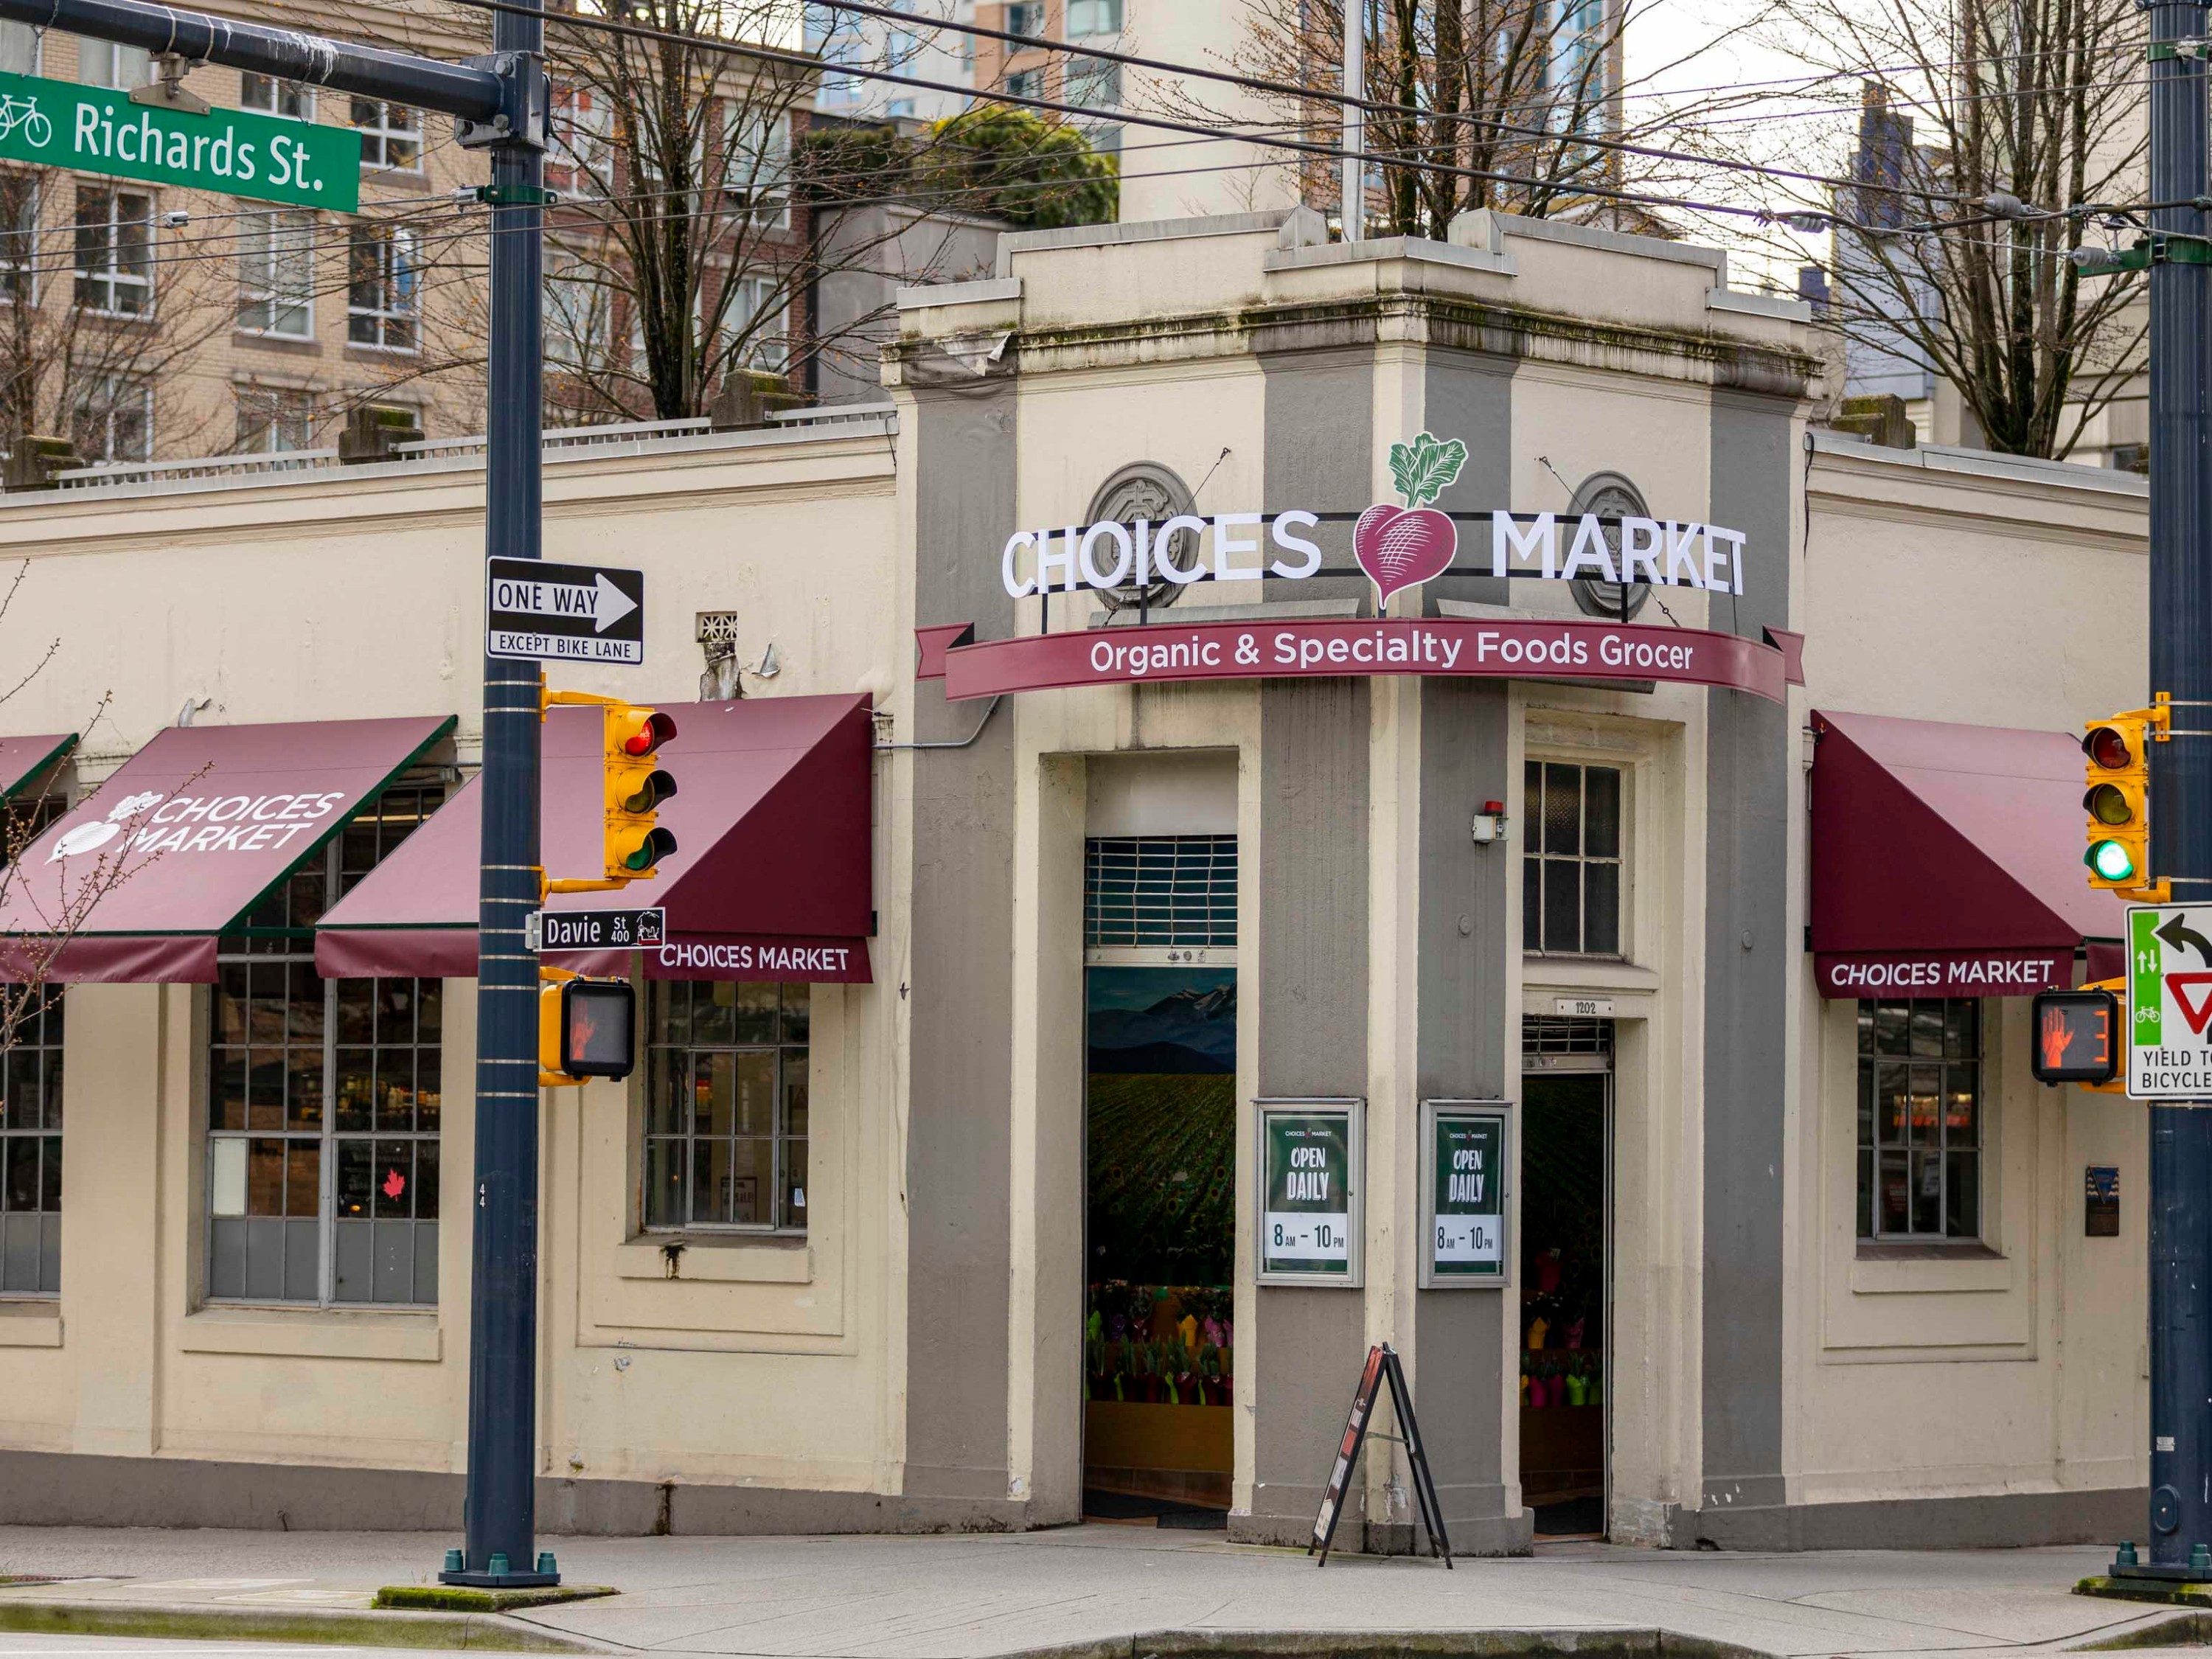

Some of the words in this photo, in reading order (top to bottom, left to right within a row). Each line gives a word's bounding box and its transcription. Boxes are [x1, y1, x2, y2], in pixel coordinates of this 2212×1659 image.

[74, 102, 255, 181] Richards
[268, 135, 323, 192] St.
[1001, 509, 1322, 599] CHOICES
[1492, 509, 1746, 597] MARKET
[498, 583, 542, 611] ONE
[553, 588, 598, 615] WAY
[500, 635, 550, 653] EXCEPT
[557, 639, 588, 655] BIKE
[596, 641, 630, 658] LANE
[1091, 634, 1220, 675] Organic
[1234, 633, 1260, 665] &
[1273, 630, 1463, 669] Specialty
[1478, 632, 1588, 665] Foods
[1599, 634, 1694, 669] Grocer
[150, 792, 345, 824] CHOICES
[115, 822, 314, 853] MARKET
[547, 915, 601, 945] Davie
[613, 916, 627, 931] St
[611, 930, 630, 943] 400
[659, 944, 752, 969] CHOICES
[759, 947, 849, 970] MARKET
[1831, 961, 1941, 987] CHOICES
[1947, 959, 2054, 984] MARKET
[1576, 1001, 1596, 1015] 1202
[2093, 1009, 2110, 1063] 3
[2143, 1051, 2191, 1067] YIELD
[2199, 1051, 2212, 1066] T
[2142, 1072, 2212, 1088] BICYCLE
[1290, 1147, 1326, 1168] OPEN
[1453, 1149, 1482, 1170] OPEN
[1286, 1172, 1330, 1201] DAILY
[1449, 1174, 1484, 1203] DAILY
[1274, 1223, 1284, 1247] 8
[1285, 1236, 1296, 1247] AM
[1315, 1224, 1332, 1248] 10
[1333, 1237, 1344, 1248] PM
[1437, 1226, 1445, 1250] 8
[1446, 1239, 1455, 1249] AM
[1470, 1226, 1484, 1250] 10
[1484, 1239, 1493, 1250] PM
